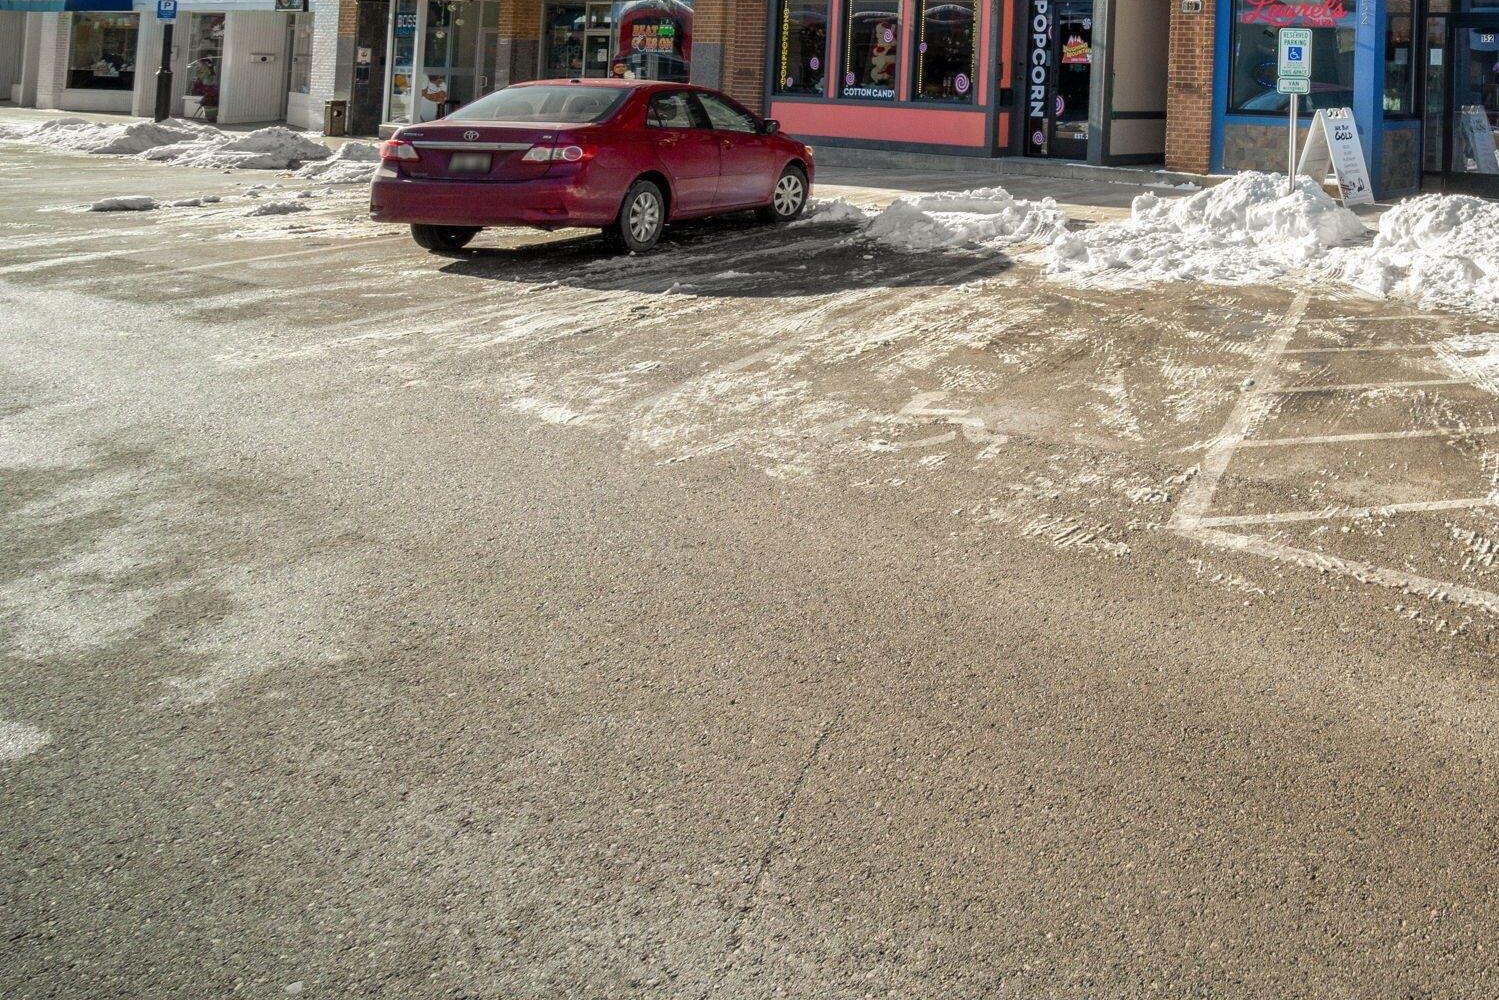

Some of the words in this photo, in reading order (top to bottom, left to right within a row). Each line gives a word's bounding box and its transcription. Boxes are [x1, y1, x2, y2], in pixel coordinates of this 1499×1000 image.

[1283, 31, 1309, 39] RESERVED
[1030, 0, 1048, 118] POPCORN
[843, 87, 872, 97] COTTON
